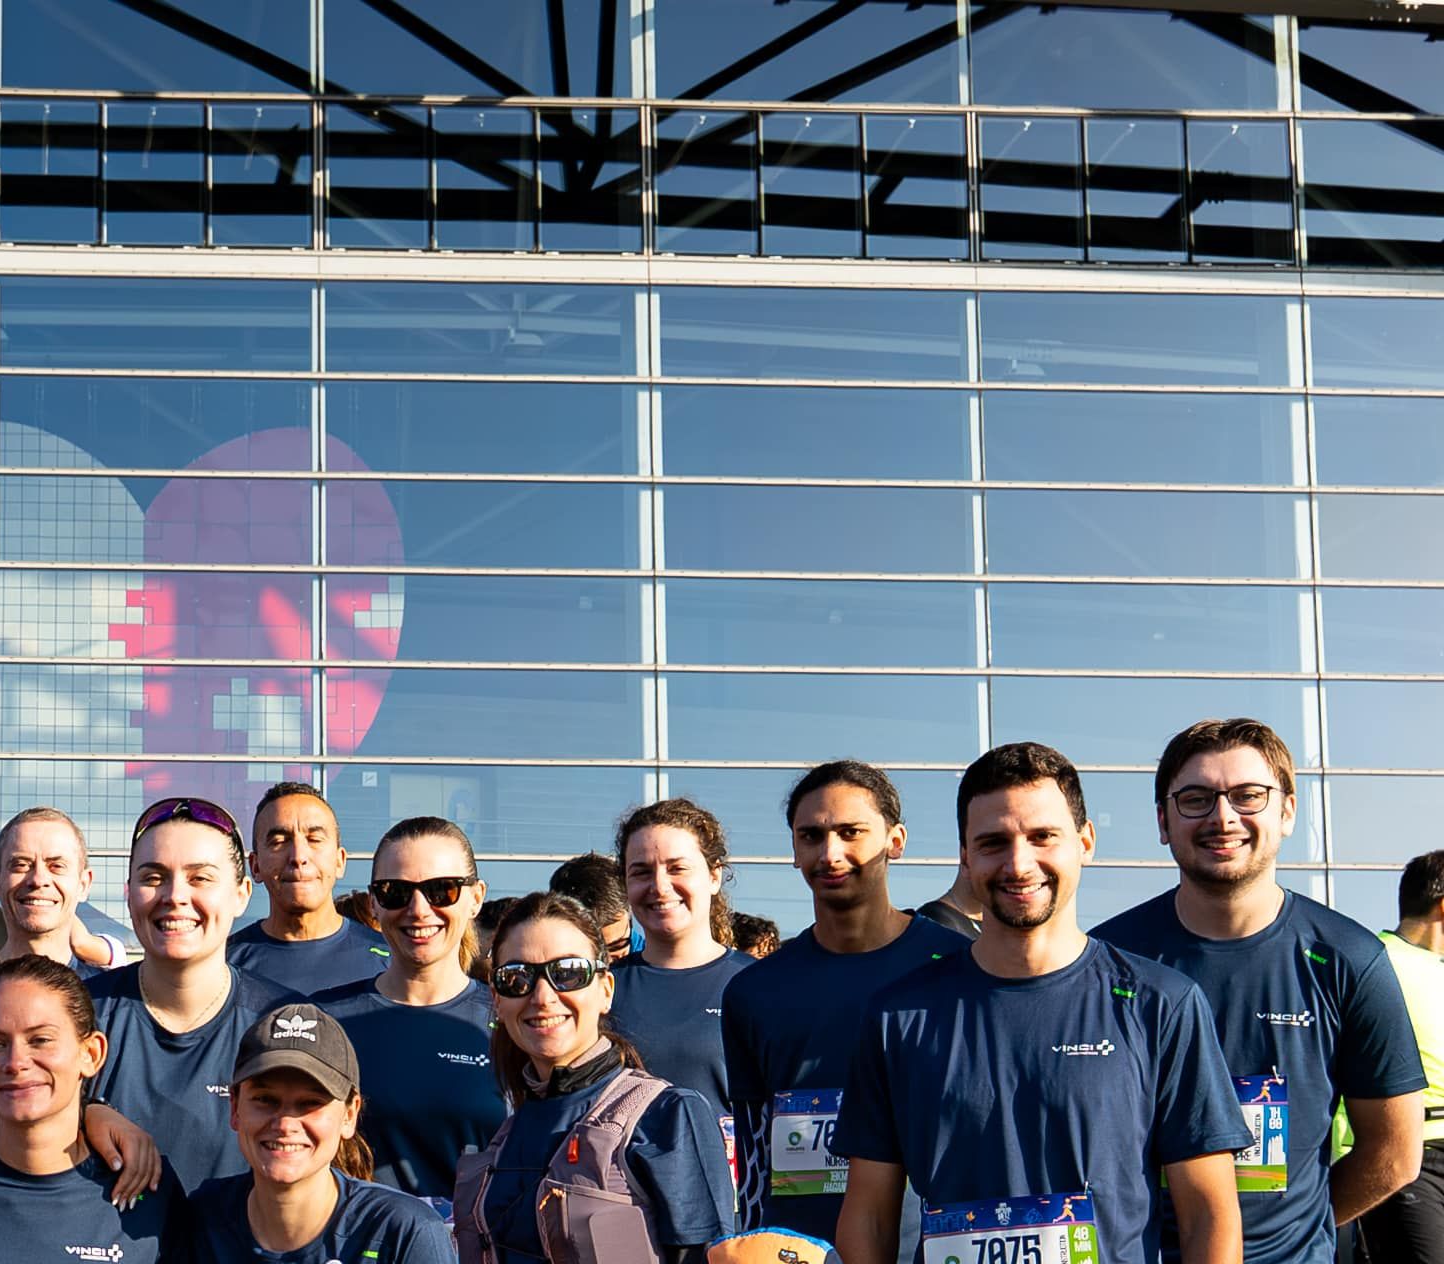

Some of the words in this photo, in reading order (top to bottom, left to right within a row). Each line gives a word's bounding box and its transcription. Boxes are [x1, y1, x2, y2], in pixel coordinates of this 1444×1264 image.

[1256, 1013, 1297, 1021] VINCI
[273, 1029, 316, 1042] adidas
[1051, 1043, 1094, 1052] VINCI
[437, 1052, 473, 1061] VINCI
[65, 1245, 106, 1256] VINCI
